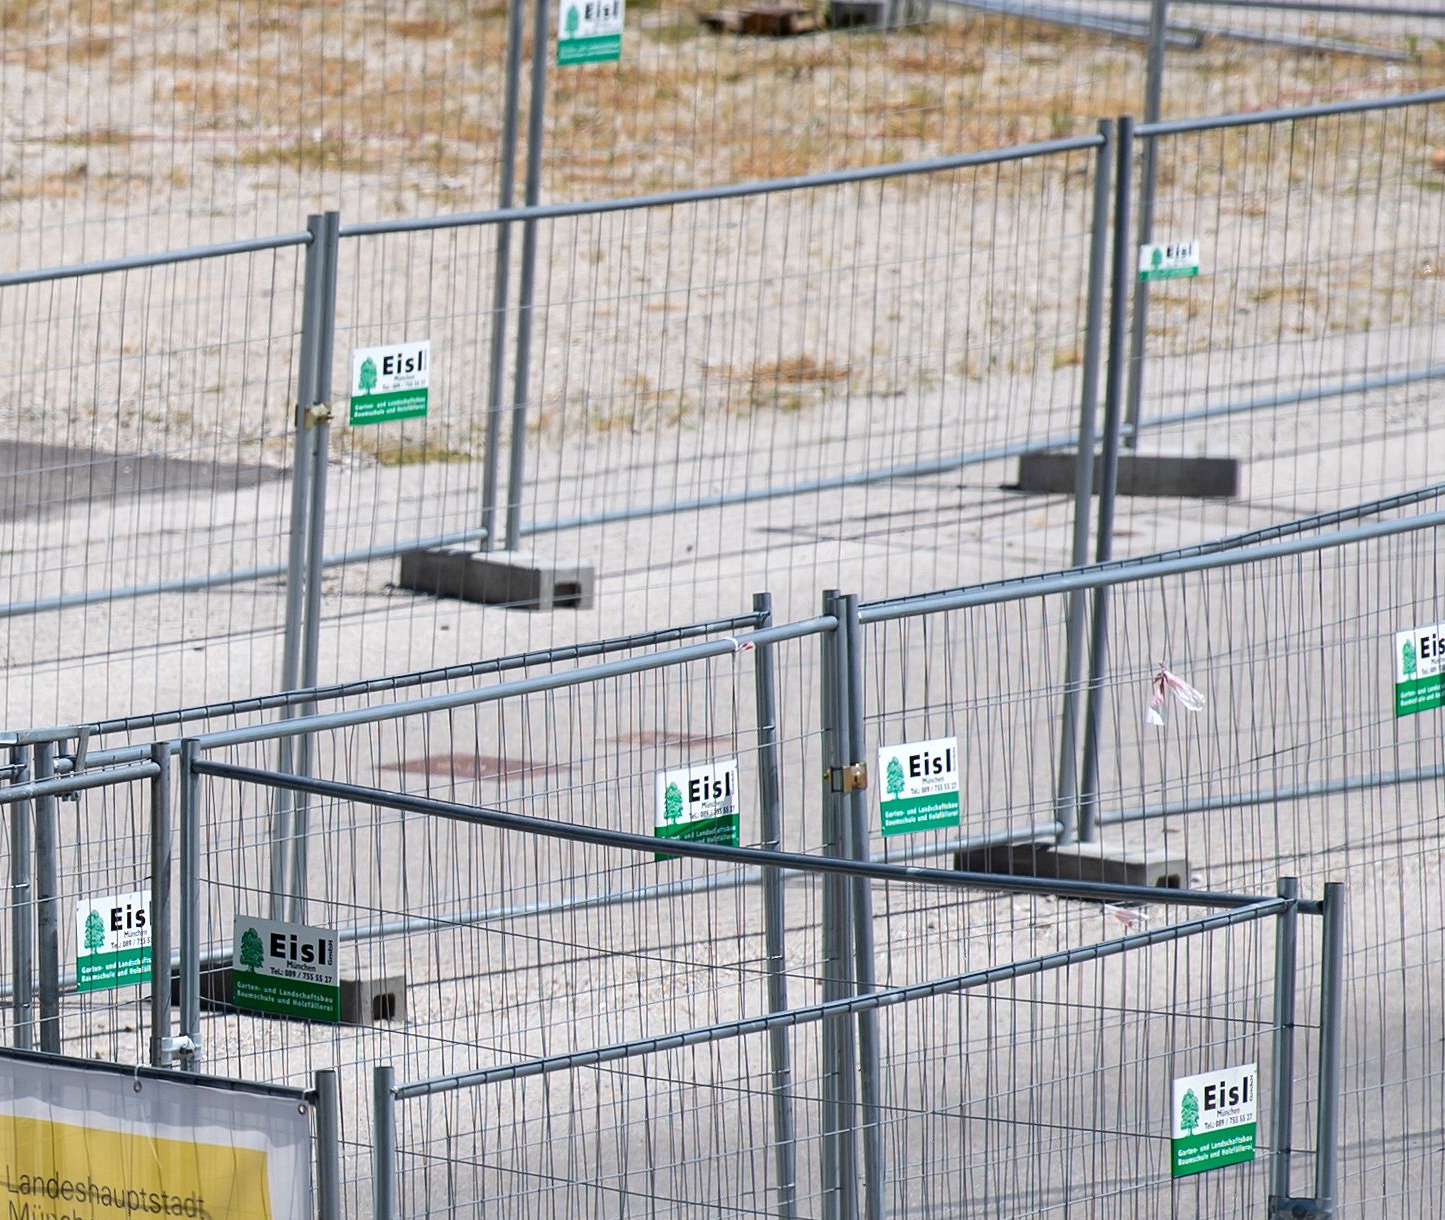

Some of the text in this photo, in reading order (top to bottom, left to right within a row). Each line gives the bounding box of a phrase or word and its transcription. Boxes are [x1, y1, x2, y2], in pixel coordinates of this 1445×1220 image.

[382, 351, 423, 376] Eisl
[909, 749, 952, 778] Eisl
[689, 771, 730, 803] Eisl
[906, 807, 917, 815] und
[917, 814, 927, 822] und
[270, 932, 326, 966] Eisl
[271, 966, 284, 976] Tel.:
[285, 969, 296, 978] 089
[302, 972, 314, 981] 755
[316, 975, 323, 983] 55
[325, 976, 332, 984] 27
[286, 960, 316, 973] München
[236, 981, 332, 1004] Garten- und Landschaftsbau
[237, 989, 332, 1012] Baumschule und Holzfällerei
[1204, 1076, 1248, 1111] Eisl
[1200, 1143, 1210, 1152] und
[1210, 1150, 1220, 1159] und
[6, 1164, 205, 1220] Landeshauptstadt
